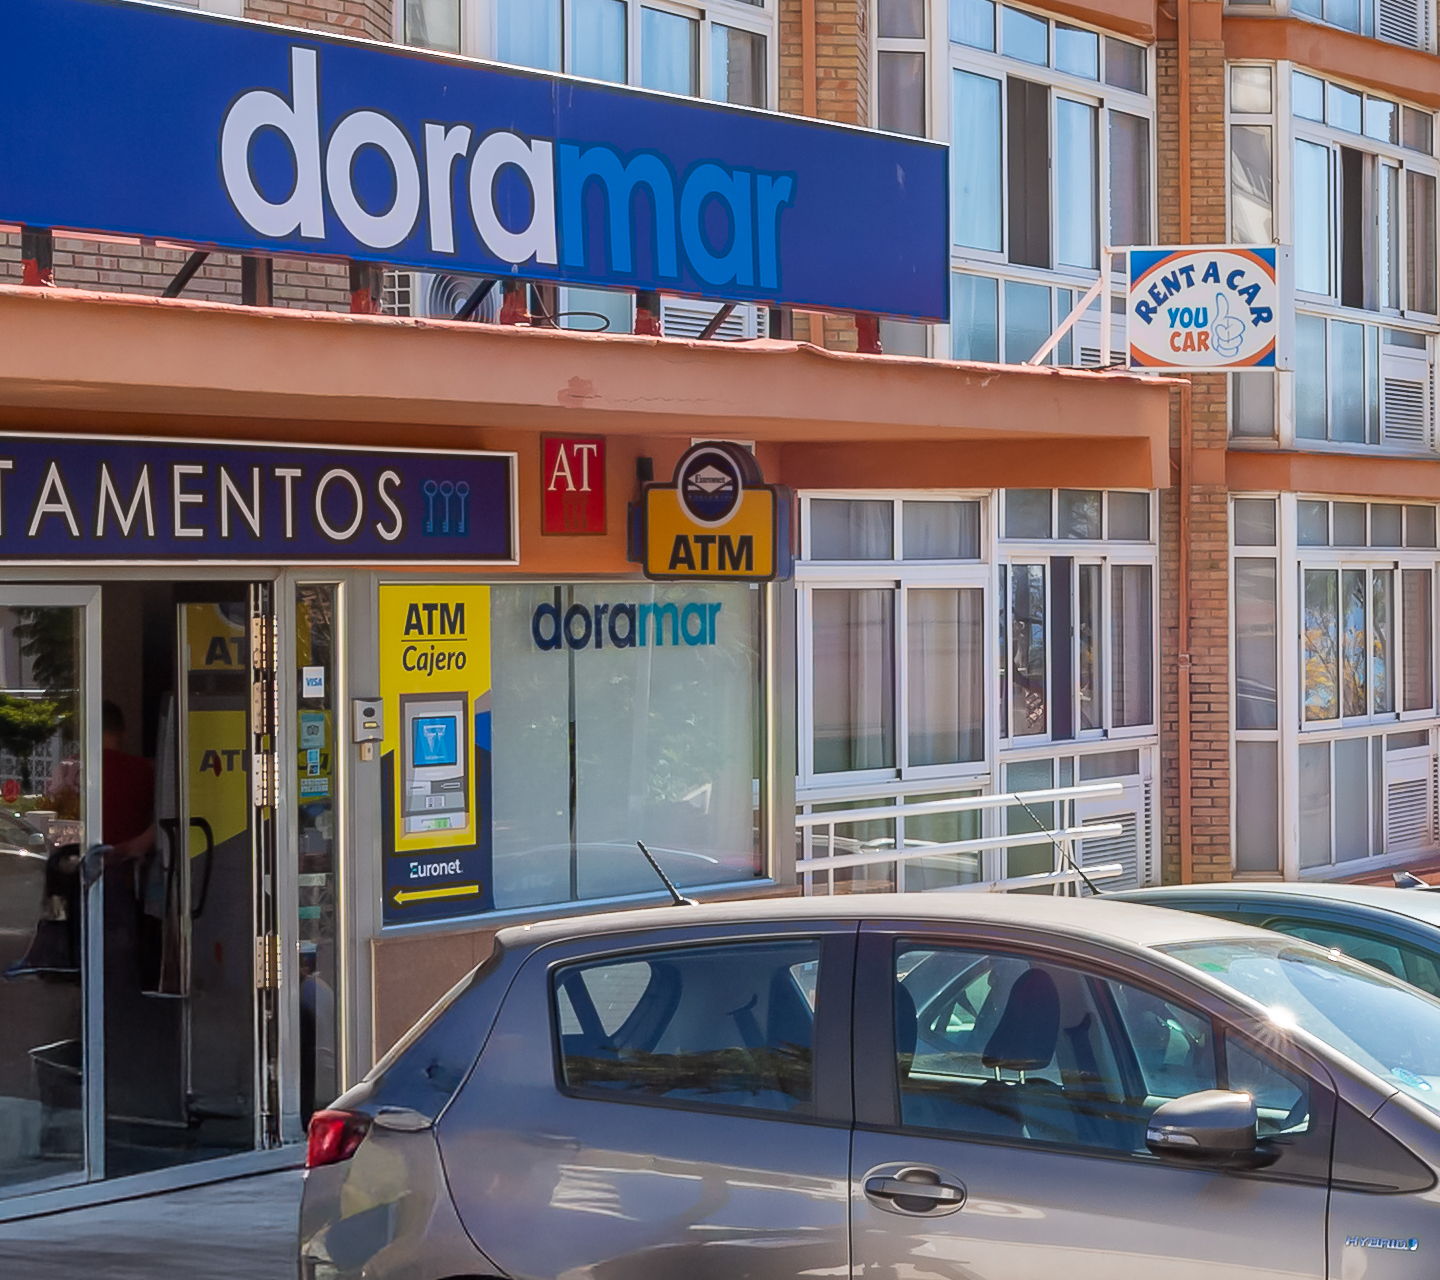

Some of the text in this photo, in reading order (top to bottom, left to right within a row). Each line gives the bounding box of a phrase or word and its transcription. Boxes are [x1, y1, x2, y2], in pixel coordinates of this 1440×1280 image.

[220, 46, 794, 290] doramar
[1135, 261, 1273, 327] RENT A CAR
[1167, 307, 1209, 328] YOU
[1169, 331, 1210, 352] CAR
[547, 443, 598, 492] AT
[668, 534, 754, 571] ATM
[404, 603, 465, 635] ATM
[531, 585, 723, 651] doramar
[205, 636, 245, 665] AT
[402, 645, 467, 677] Cajero
[306, 677, 322, 686] VISA
[199, 749, 247, 772] AT
[410, 858, 463, 878] Euronet
[1345, 1236, 1407, 1250] HYBRID
